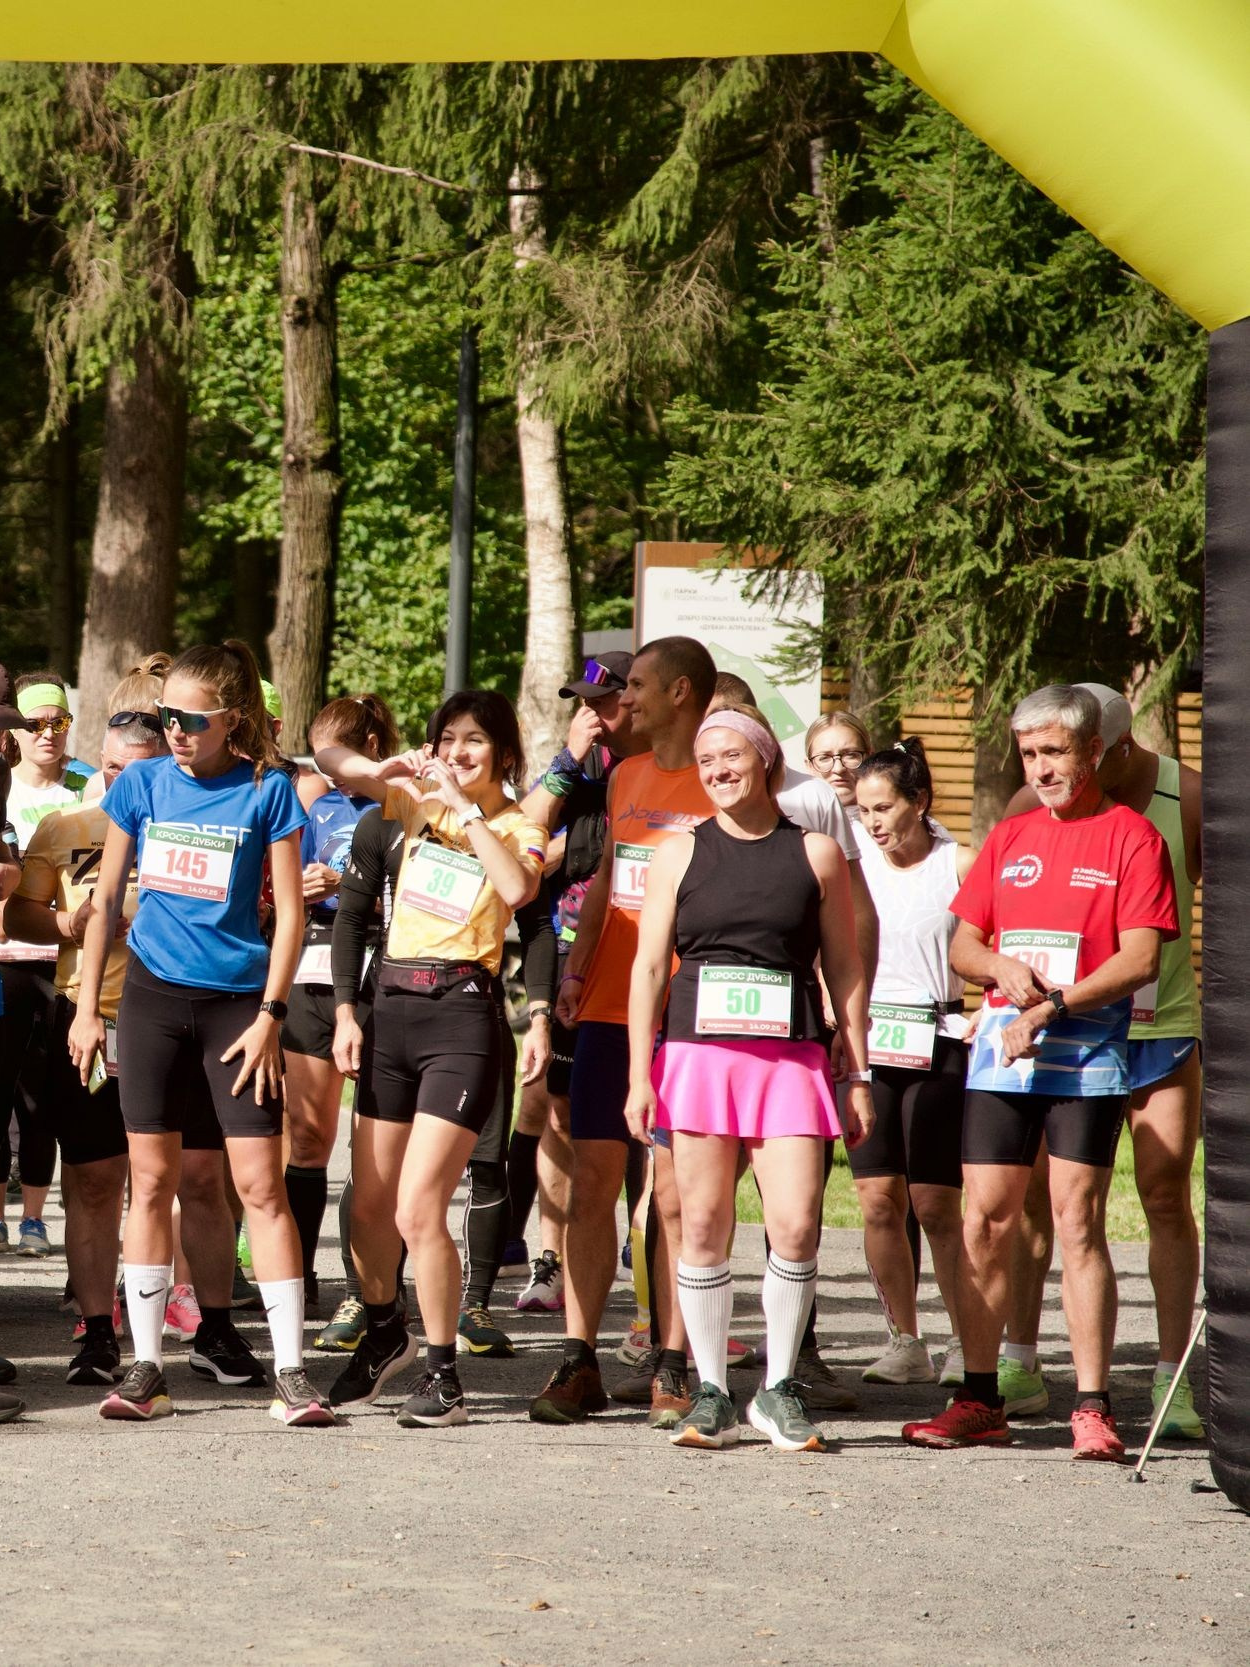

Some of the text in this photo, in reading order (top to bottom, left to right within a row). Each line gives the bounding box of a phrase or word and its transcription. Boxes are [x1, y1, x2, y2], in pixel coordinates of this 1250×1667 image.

[155, 829, 226, 849] КРОСС ДУБКИ
[621, 847, 647, 859] КРОСС
[166, 848, 209, 880] 145
[1001, 865, 1036, 879] БЕГИ
[426, 867, 457, 897] 39
[1033, 935, 1069, 946] ДУБКИ
[710, 971, 782, 983] КРОСС ДУБКИ
[726, 987, 761, 1016] 50
[868, 1008, 928, 1021] РОСС ДУБКИ
[875, 1023, 907, 1050] 28
[894, 1056, 924, 1065] 14.09.25
